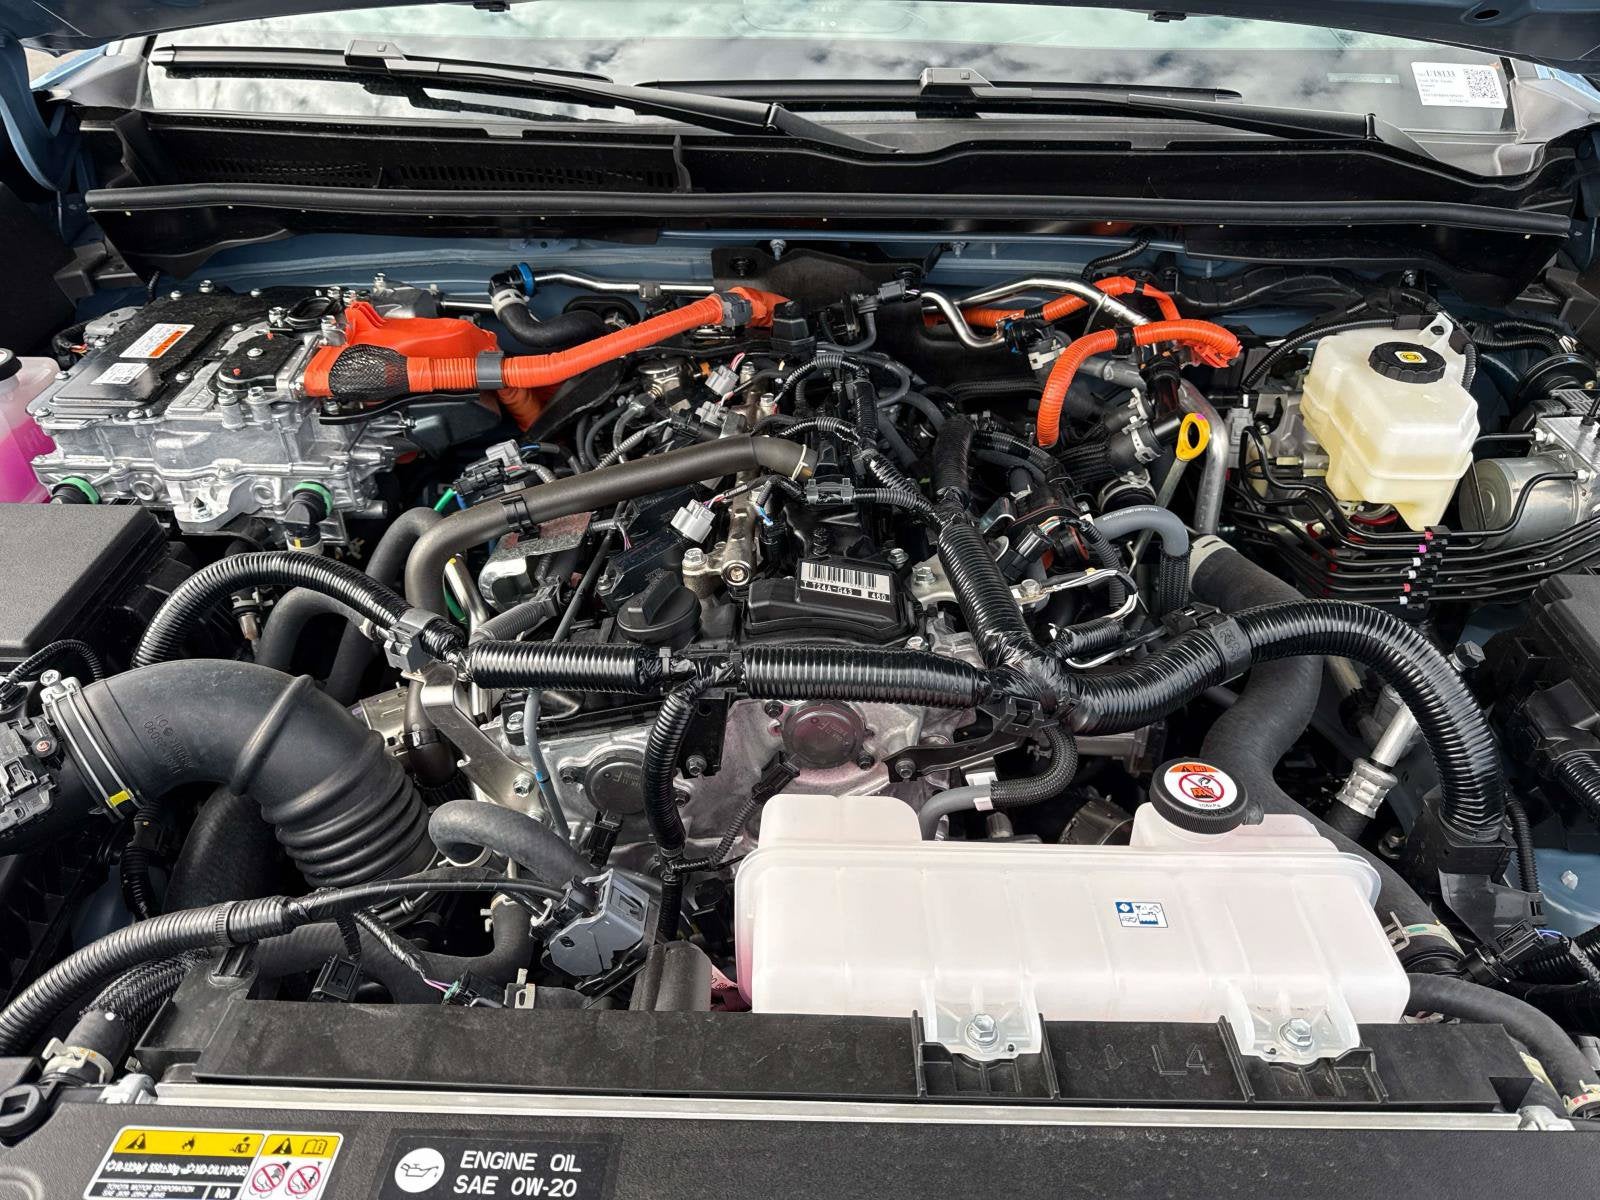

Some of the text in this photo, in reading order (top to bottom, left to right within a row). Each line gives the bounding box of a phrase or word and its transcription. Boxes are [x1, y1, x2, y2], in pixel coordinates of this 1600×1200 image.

[459, 1150, 582, 1172] ENGINE OIL
[105, 1183, 130, 1191] TOYOTA
[214, 1187, 232, 1199] NA
[453, 1175, 577, 1197] SAE 0W-20
